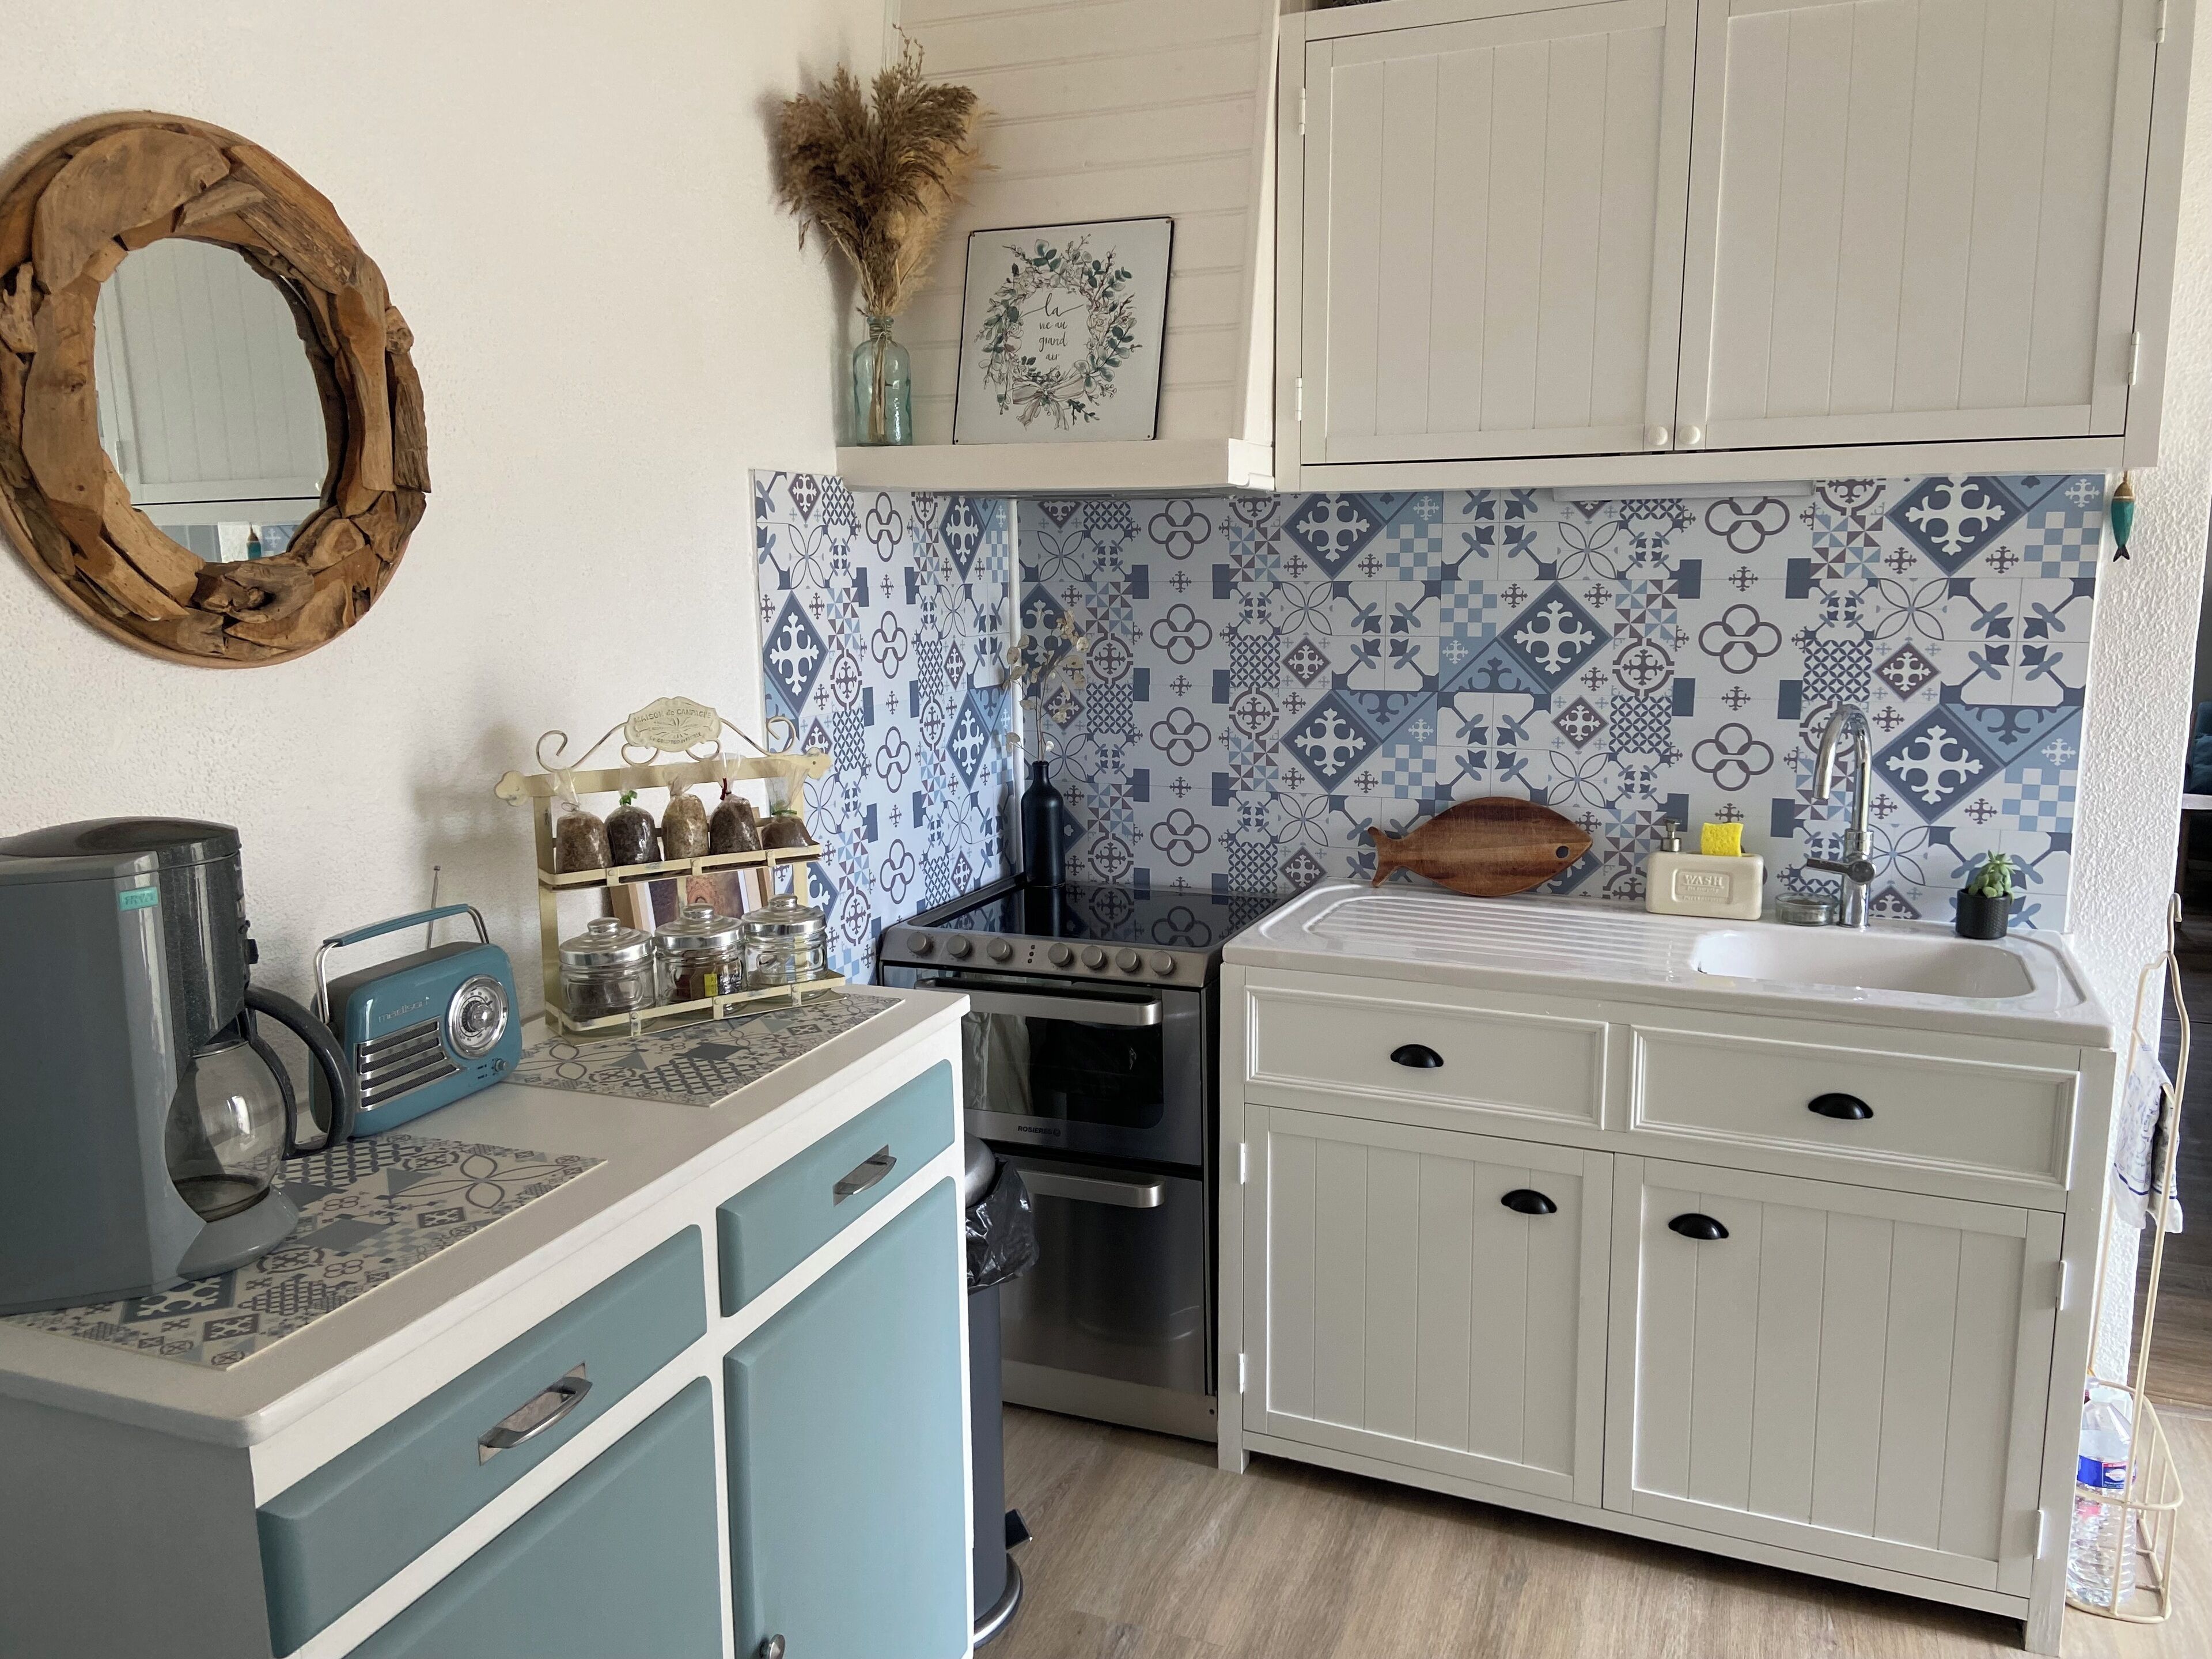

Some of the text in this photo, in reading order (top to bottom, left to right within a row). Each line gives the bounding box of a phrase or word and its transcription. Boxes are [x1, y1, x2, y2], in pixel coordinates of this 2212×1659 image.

[1055, 321, 1068, 329] au
[1039, 331, 1068, 352] grand
[634, 711, 664, 723] MAISON
[1685, 874, 1723, 886] WASH
